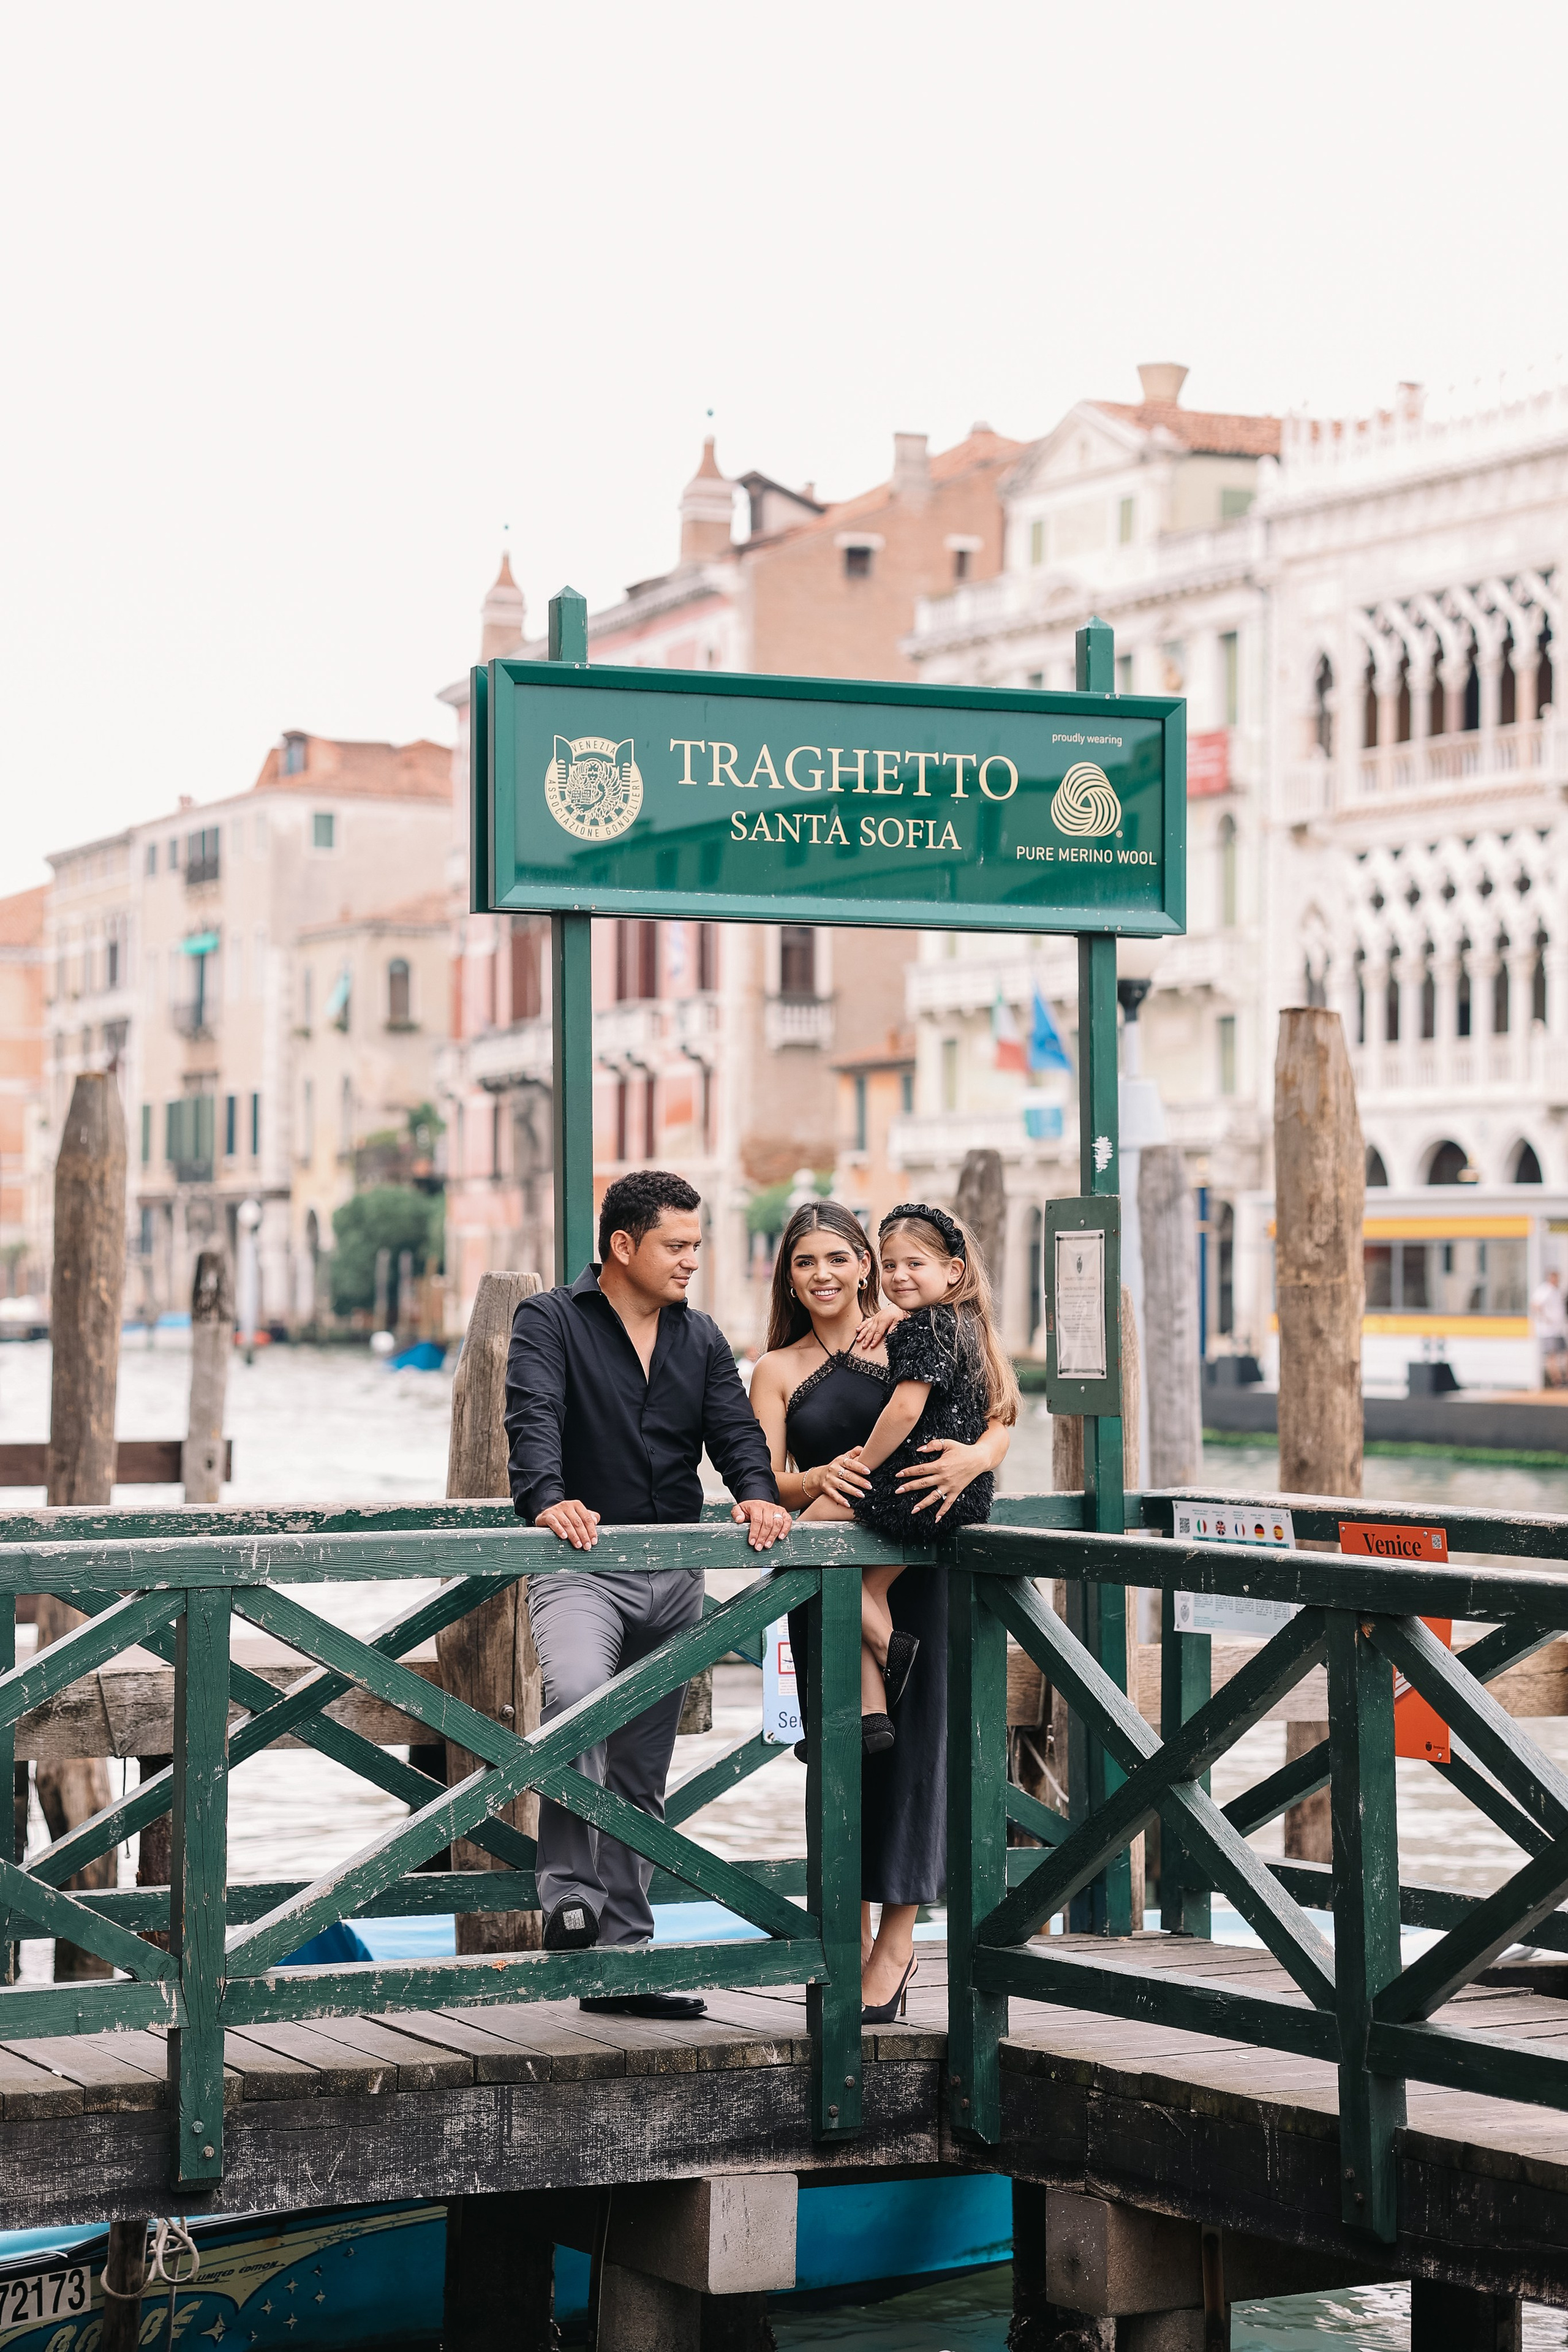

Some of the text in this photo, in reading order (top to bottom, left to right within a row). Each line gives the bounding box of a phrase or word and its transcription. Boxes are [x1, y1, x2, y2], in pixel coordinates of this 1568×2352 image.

[571, 741, 616, 755] VENEZIA
[1052, 733, 1122, 747] proudly wearing
[669, 738, 1019, 801] TRAGHETTO
[548, 779, 640, 837] ASSOCIAZIONE GONDOLIERI
[730, 811, 962, 850] SANTA SOFIA
[1016, 845, 1158, 865] PURE MERINO WOOL
[1362, 1532, 1422, 1557] Venice
[196, 2261, 280, 2282] LIMITED EDITION
